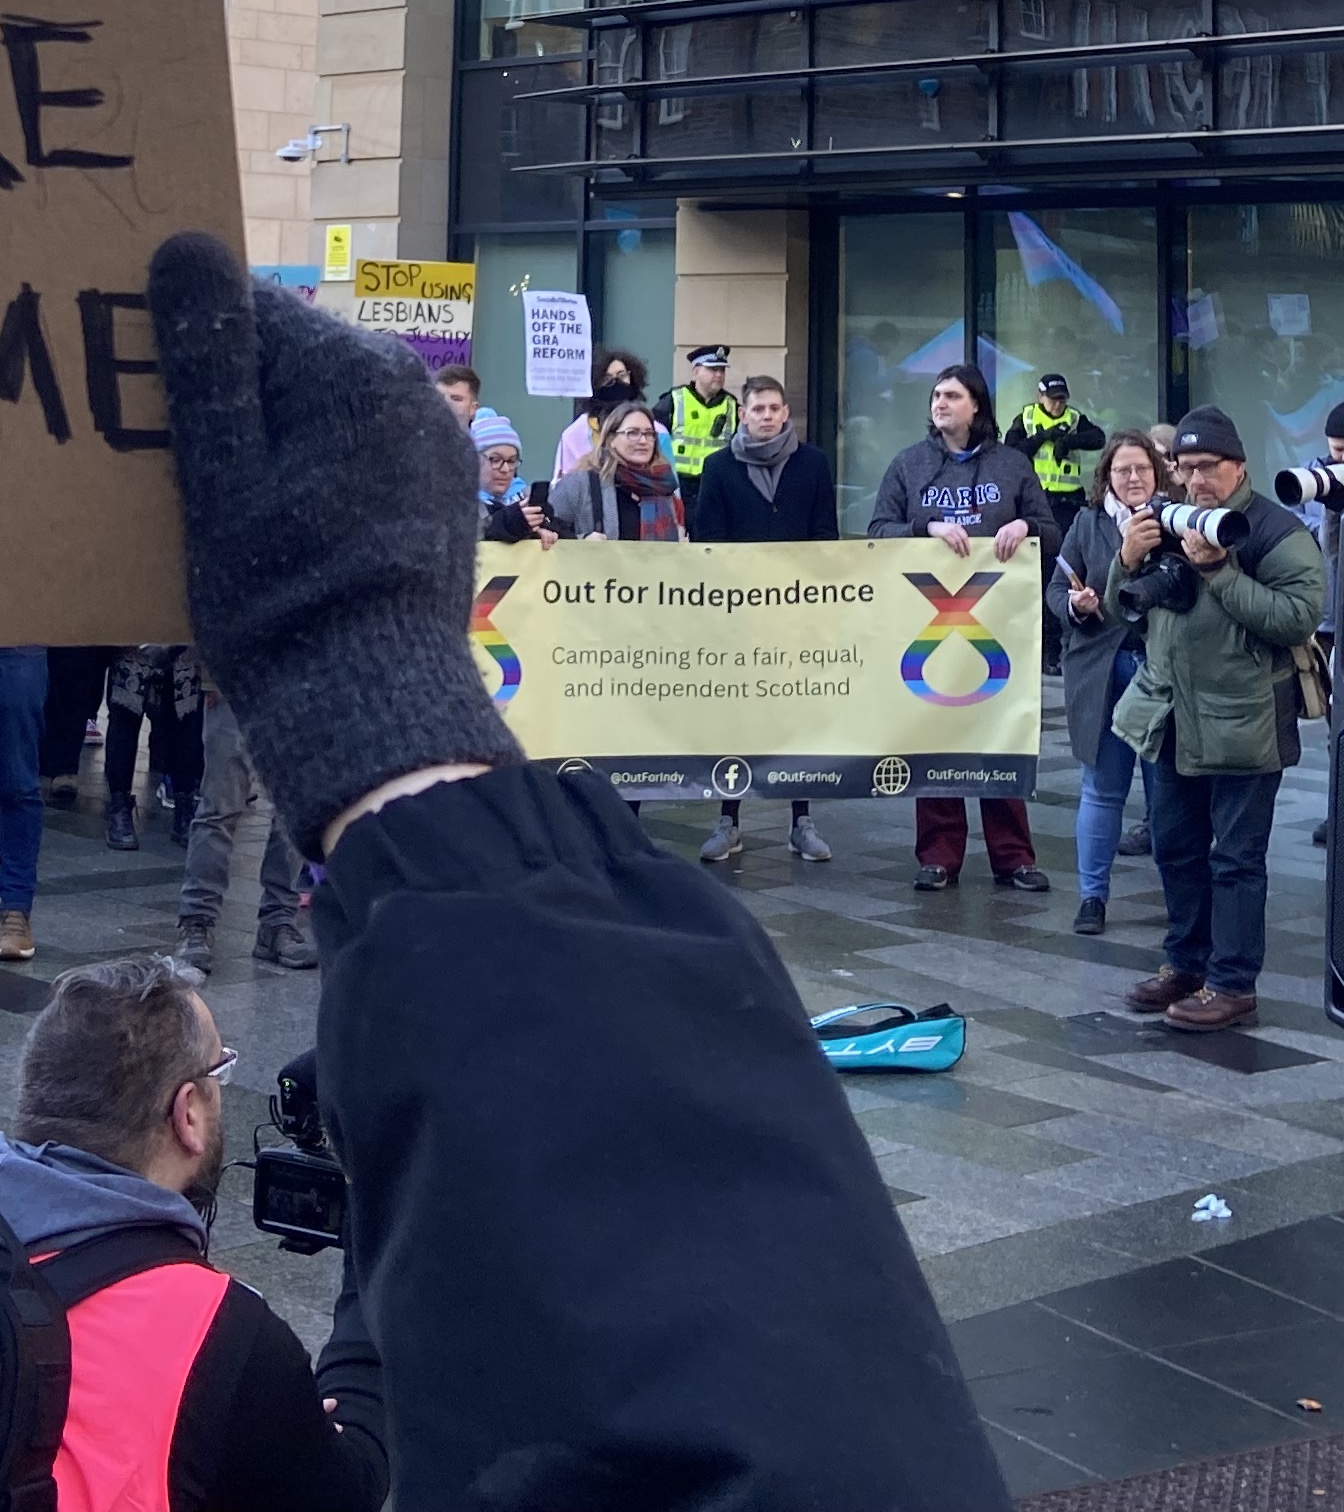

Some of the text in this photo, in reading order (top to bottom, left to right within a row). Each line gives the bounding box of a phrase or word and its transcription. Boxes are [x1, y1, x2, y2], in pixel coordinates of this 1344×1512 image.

[361, 262, 474, 304] STOP USING
[357, 301, 454, 324] LESBIANS
[531, 309, 576, 321] HANDS
[406, 327, 471, 348] JUSTIFY
[531, 322, 583, 335] OFF THE
[532, 334, 559, 346] GRA
[533, 348, 585, 360] REFORM
[922, 482, 1001, 508] PARIS
[943, 513, 982, 525] FRANCE
[542, 578, 875, 613] Out for Independence
[552, 644, 864, 670] Campaigning for a fair, equal,
[564, 677, 850, 701] and independent Scotland
[610, 769, 685, 786] @OutForIndy
[767, 769, 843, 786] @OutForIndy
[926, 768, 1017, 783] OutForIndy.Scot
